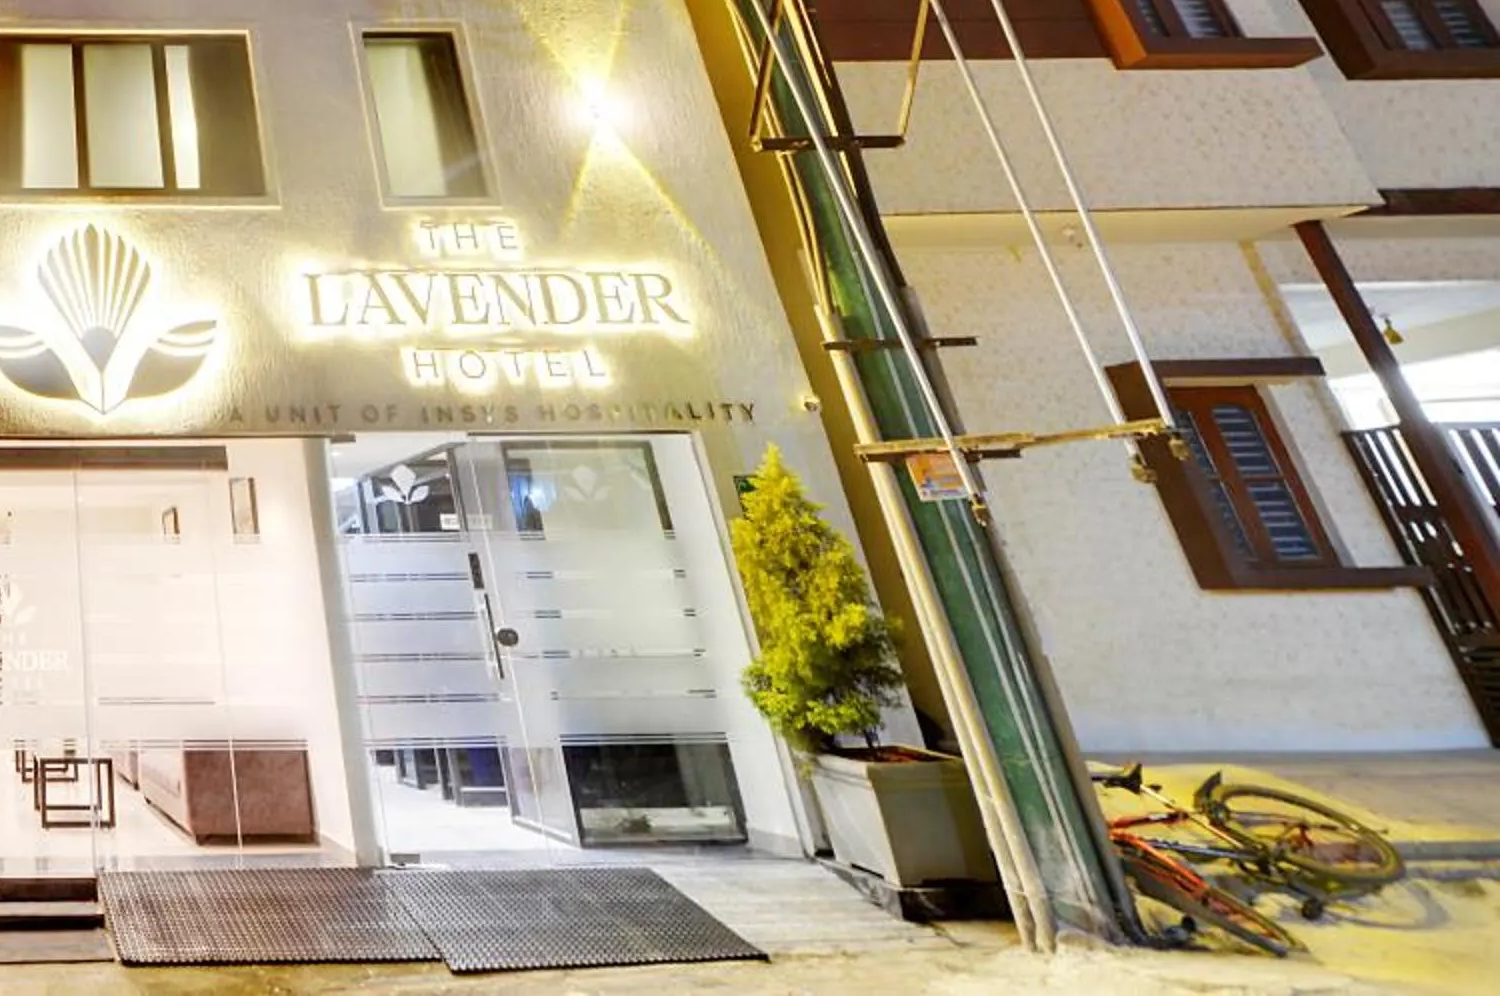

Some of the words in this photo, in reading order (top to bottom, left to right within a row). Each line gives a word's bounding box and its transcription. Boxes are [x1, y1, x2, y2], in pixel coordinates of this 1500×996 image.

[419, 220, 521, 252] THE
[302, 269, 691, 327] LAVENDER
[412, 348, 607, 380] HOTEL
[229, 404, 245, 424] A
[264, 404, 343, 424] UNIT
[360, 404, 401, 424] OF
[537, 402, 756, 424] HOSPITALITY
